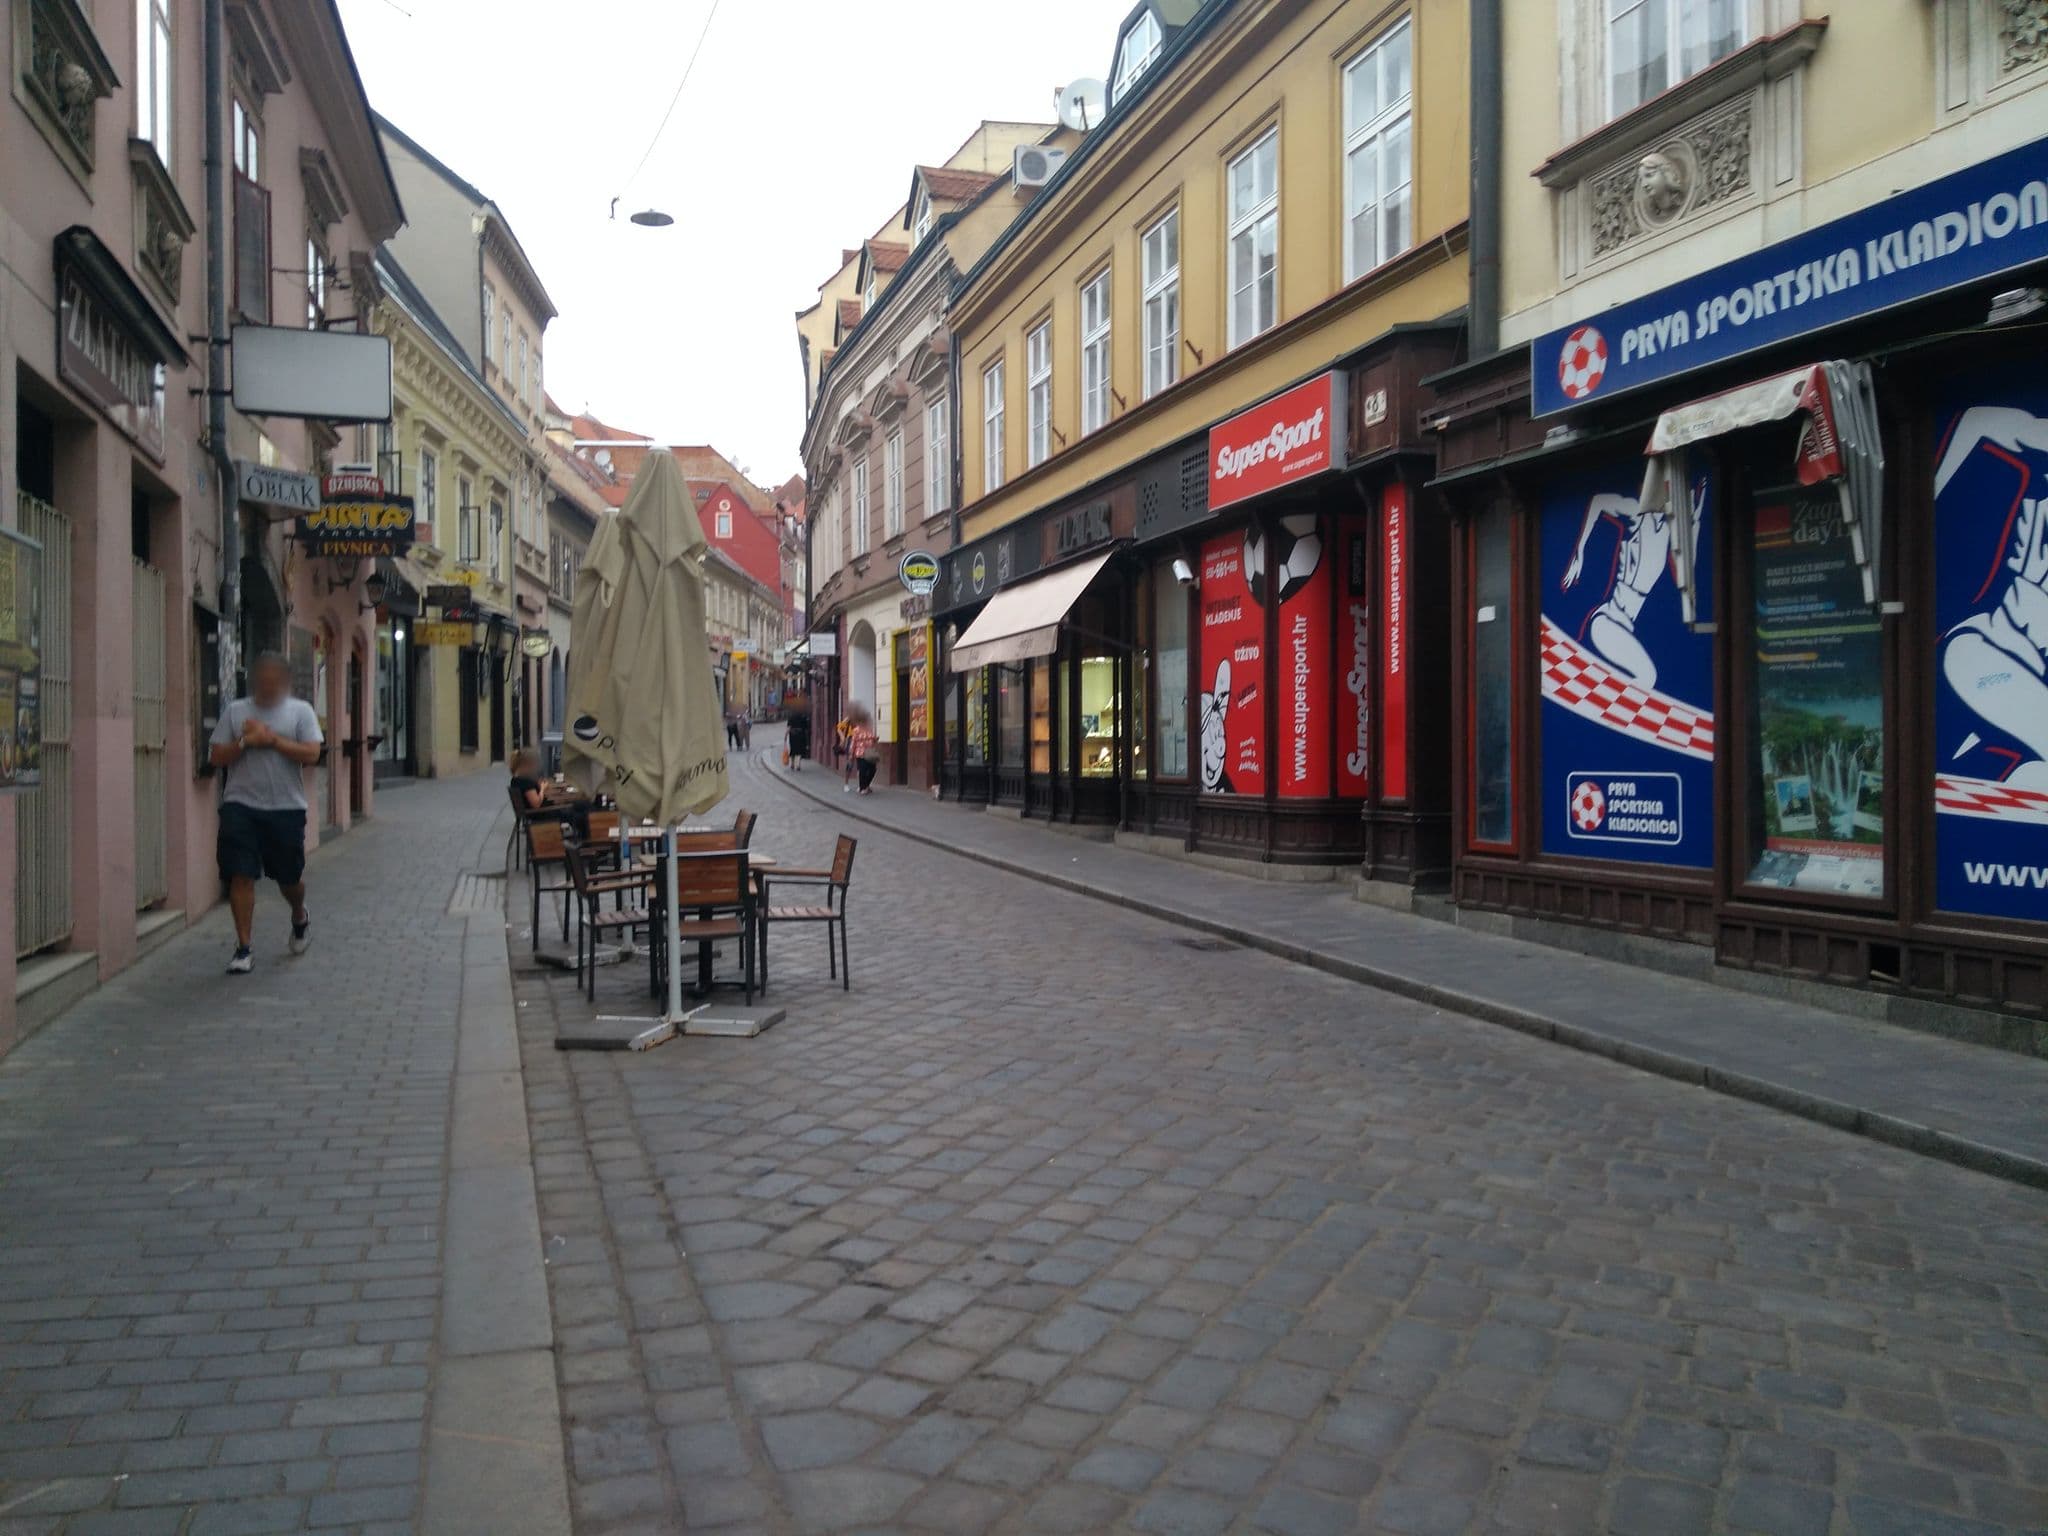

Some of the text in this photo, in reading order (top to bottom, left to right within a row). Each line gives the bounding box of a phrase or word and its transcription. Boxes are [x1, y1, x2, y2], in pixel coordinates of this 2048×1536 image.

[1620, 180, 2048, 365] PRVA SPORTSKA KLADION
[1215, 407, 1325, 480] SuperSport
[246, 475, 315, 507] OBLAK
[1389, 505, 1401, 675] www.supersport.hr
[1292, 614, 1310, 783] www.supersport.hr
[1607, 782, 1637, 797] PRVA
[1607, 799, 1664, 816] SPORTSKA
[1607, 816, 1678, 835] KLADIONICA
